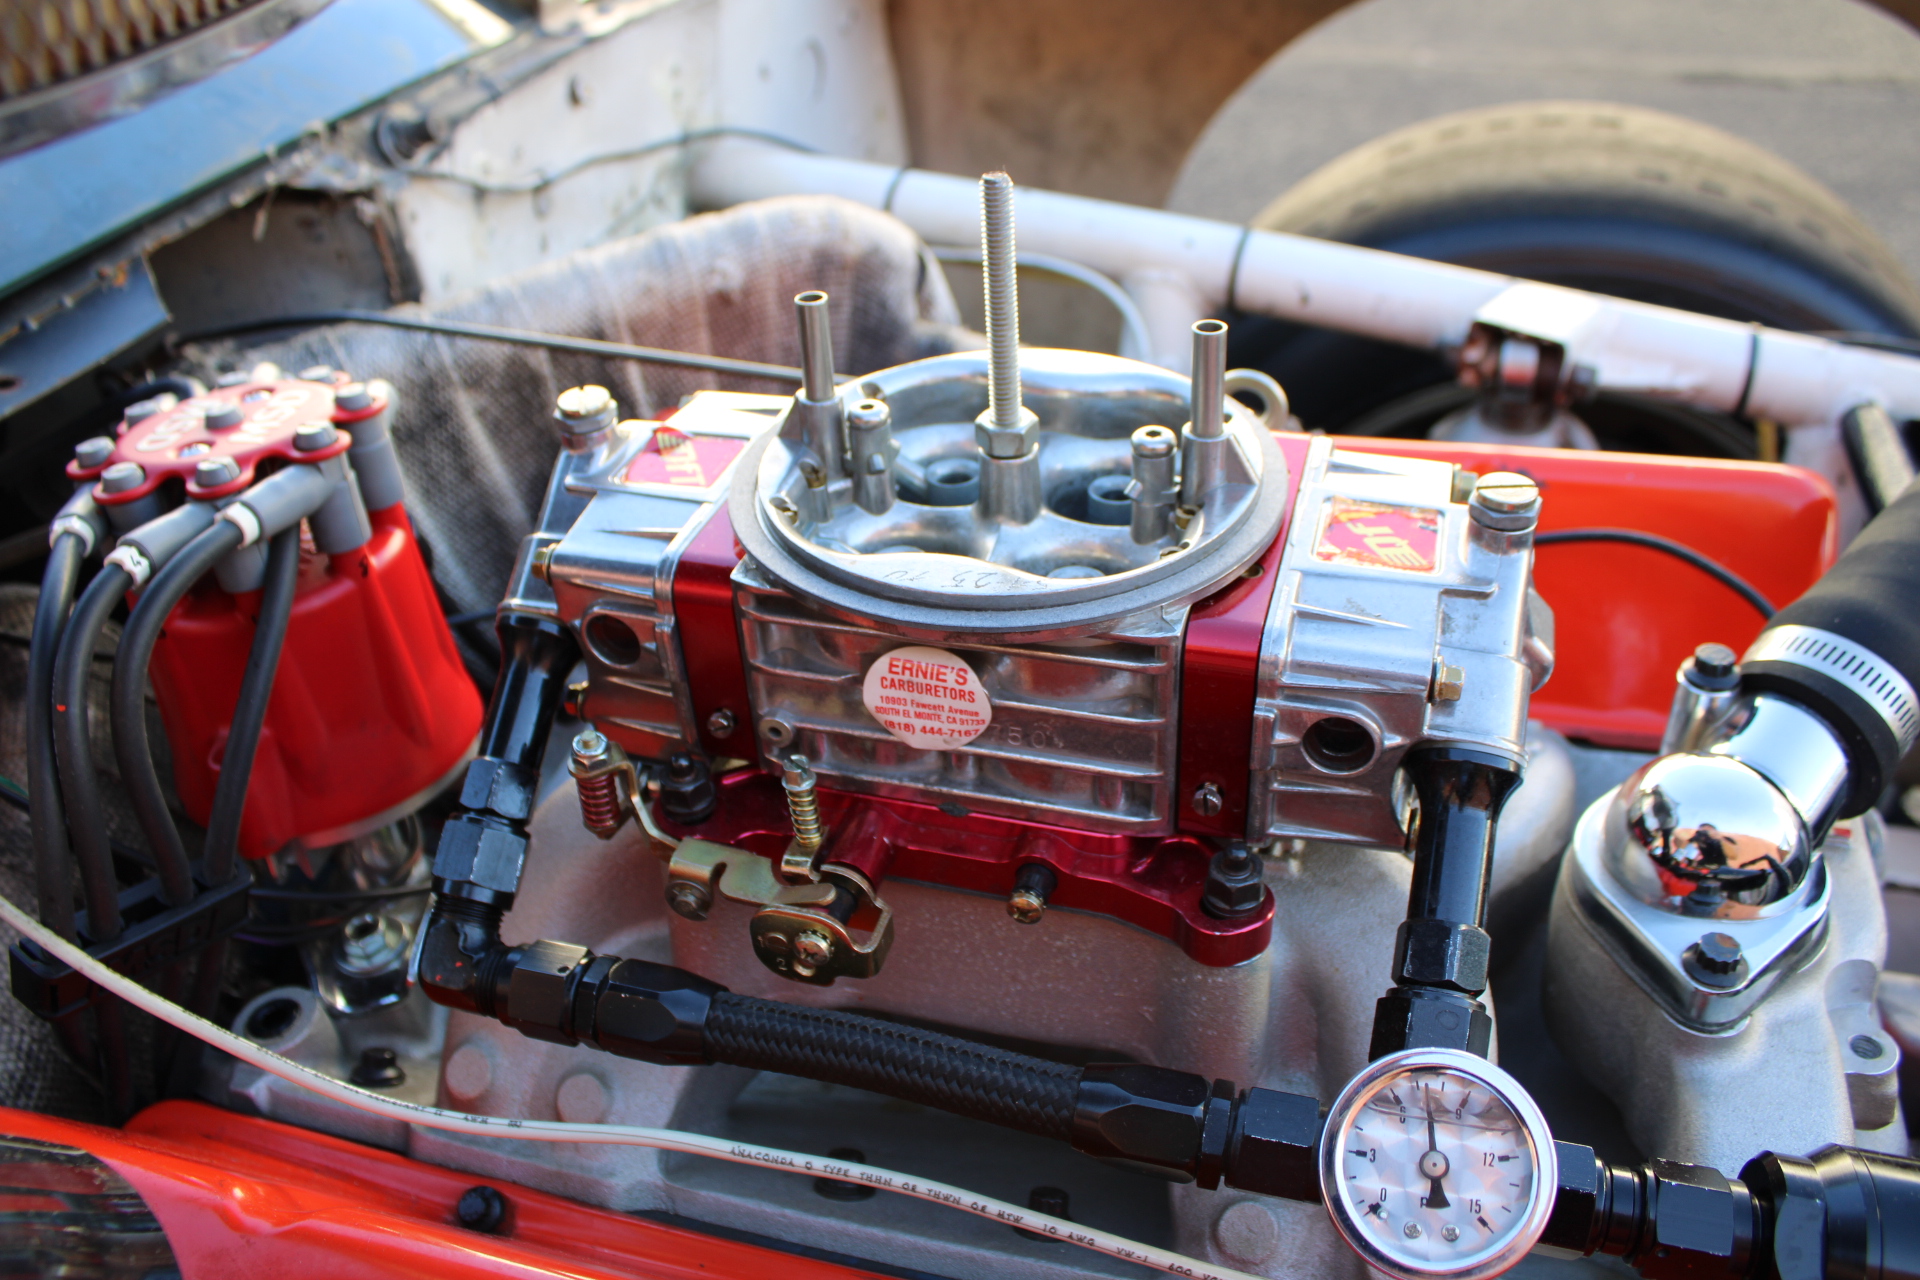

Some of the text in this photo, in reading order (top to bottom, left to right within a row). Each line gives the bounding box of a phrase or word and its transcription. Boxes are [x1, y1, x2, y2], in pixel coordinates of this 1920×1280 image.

[888, 657, 968, 686] ERNIE'S
[880, 676, 976, 704] CARBURETORS
[875, 706, 986, 727] SOUTH EL MONTE, CA 91733
[880, 695, 980, 717] 10903 Fawcett Avenue
[884, 720, 980, 738] (818) 444-7167
[1400, 1105, 1463, 1124] 6 9
[1369, 1148, 1496, 1167] 3 12
[729, 1145, 795, 1168] ANACONDA
[823, 1163, 850, 1178] TYPE
[860, 1171, 893, 1188] THHN
[902, 1181, 917, 1193] OR
[926, 1187, 961, 1206] THWN
[970, 1201, 988, 1214] OR
[1043, 1223, 1057, 1236] 10
[1068, 1231, 1096, 1247] AWG
[1168, 1262, 1193, 1277] 600
[1380, 1187, 1388, 1203] 0
[1469, 1198, 1483, 1215] 15
